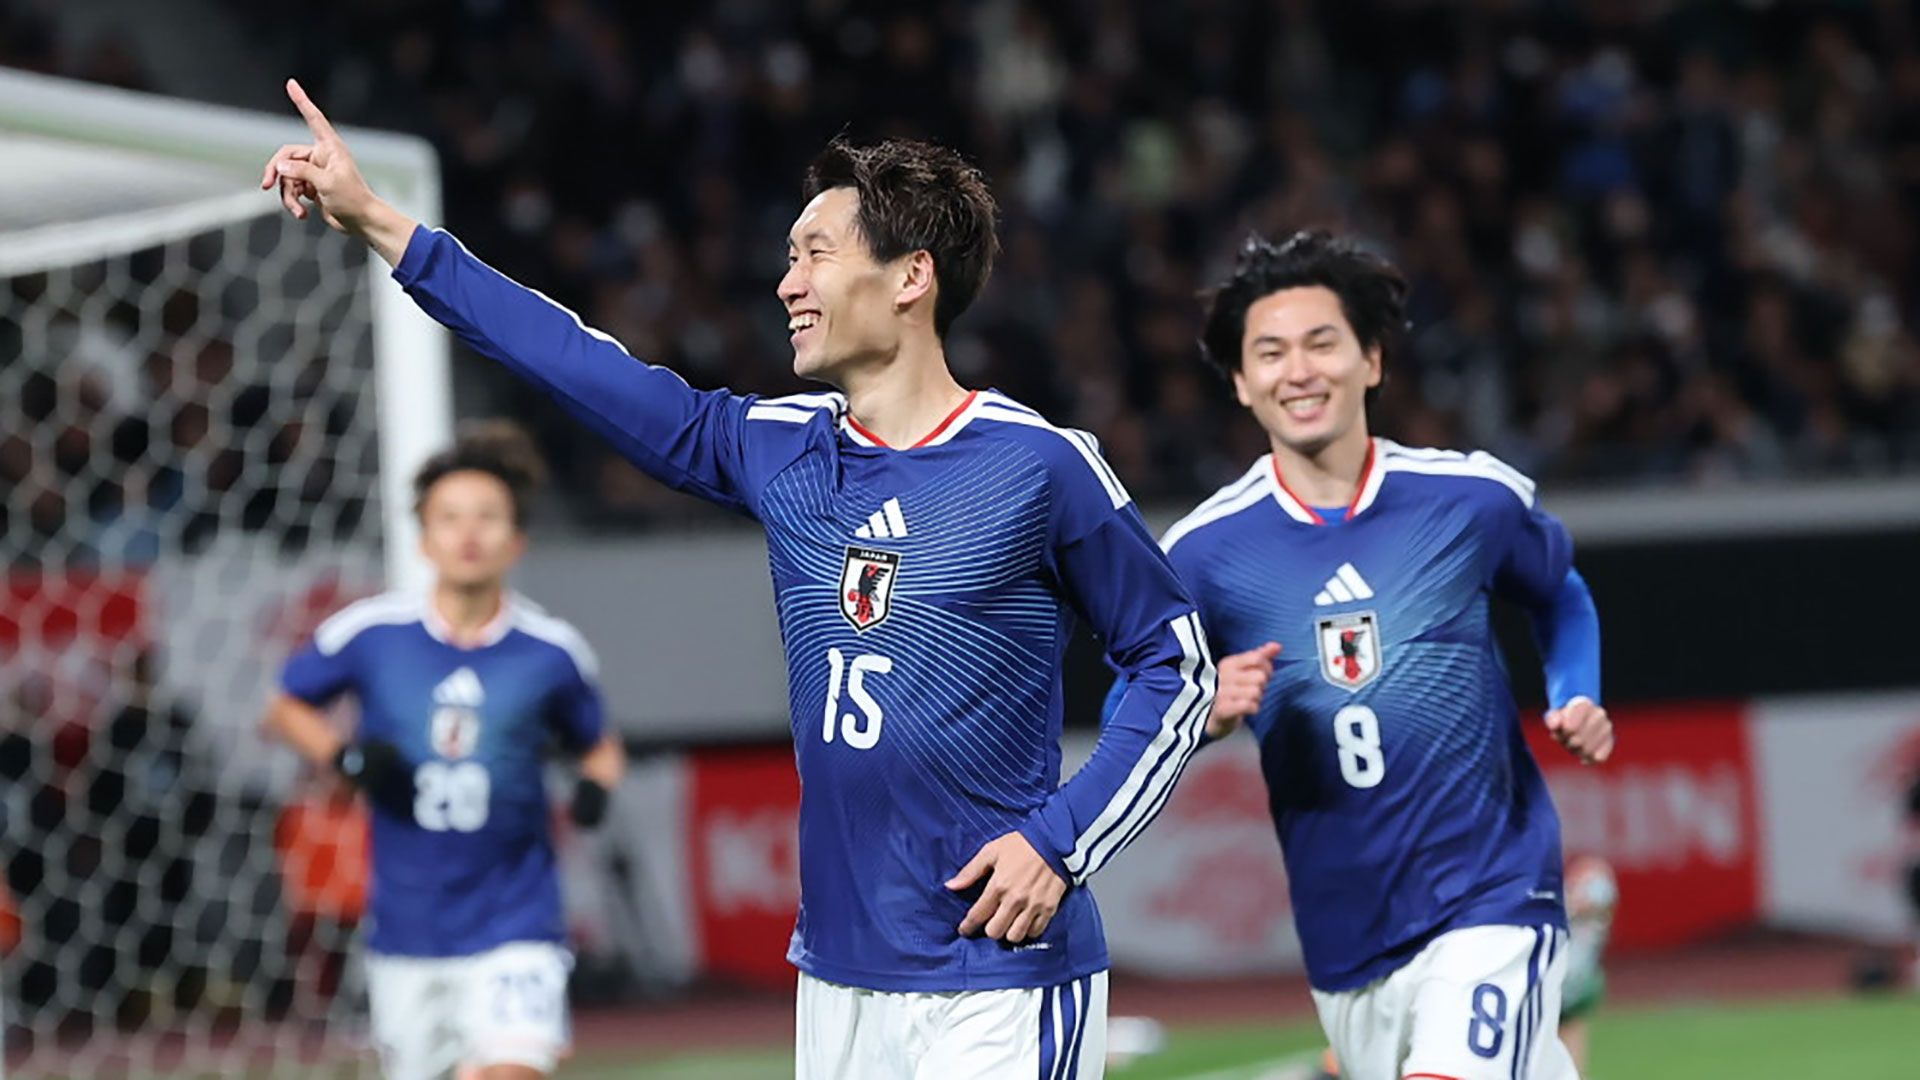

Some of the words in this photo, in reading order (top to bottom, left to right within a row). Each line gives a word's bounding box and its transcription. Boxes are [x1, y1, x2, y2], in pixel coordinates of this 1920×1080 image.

[823, 647, 893, 749] 15
[1333, 704, 1385, 789] 8
[413, 760, 491, 832] 20
[1467, 983, 1507, 1059] 8
